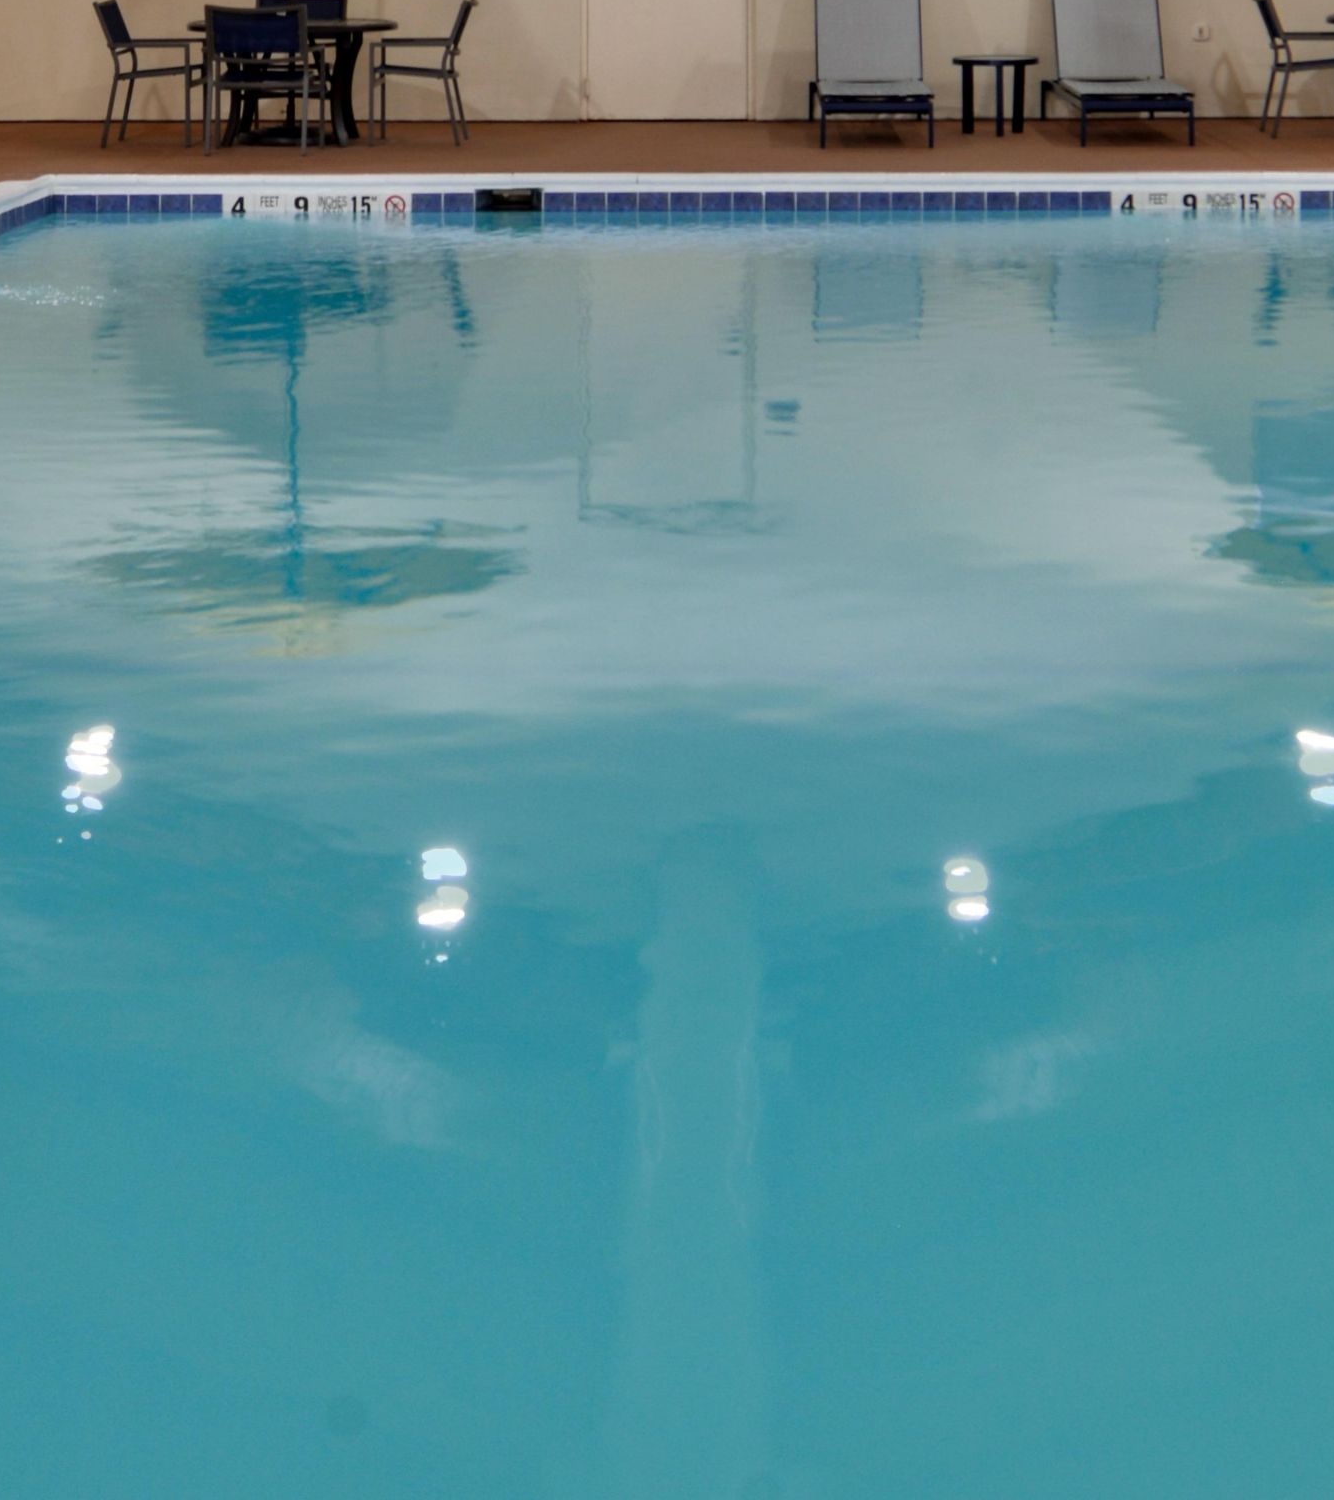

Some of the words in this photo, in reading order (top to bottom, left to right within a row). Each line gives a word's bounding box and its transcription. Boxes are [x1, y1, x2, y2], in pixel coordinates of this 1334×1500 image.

[231, 196, 246, 213] 4
[260, 195, 280, 208] FEET
[294, 196, 309, 212] 9
[1121, 194, 1135, 210] 4
[1182, 194, 1198, 210] 9
